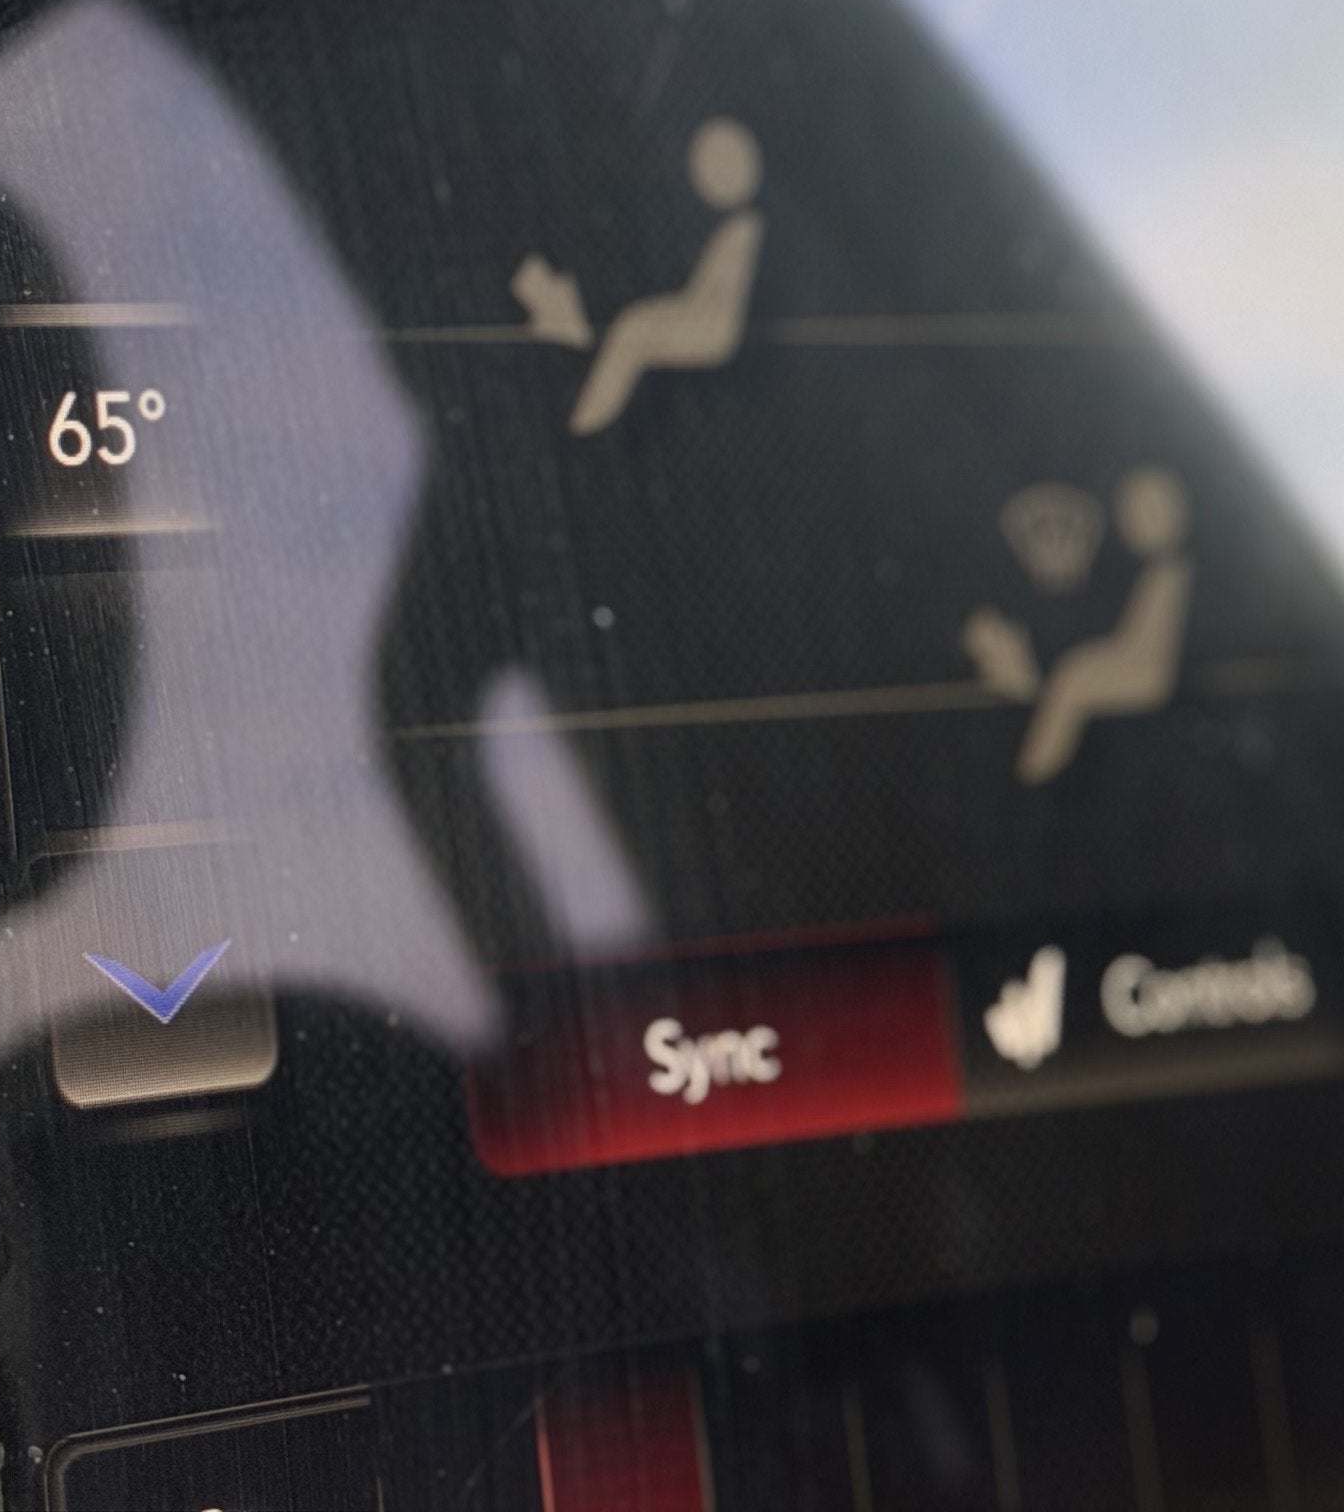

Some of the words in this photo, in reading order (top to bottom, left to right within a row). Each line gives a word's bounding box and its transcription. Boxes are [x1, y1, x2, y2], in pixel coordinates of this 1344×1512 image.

[49, 389, 166, 466] 65°
[1101, 937, 1316, 1037] Controls
[644, 1018, 782, 1104] Sync
